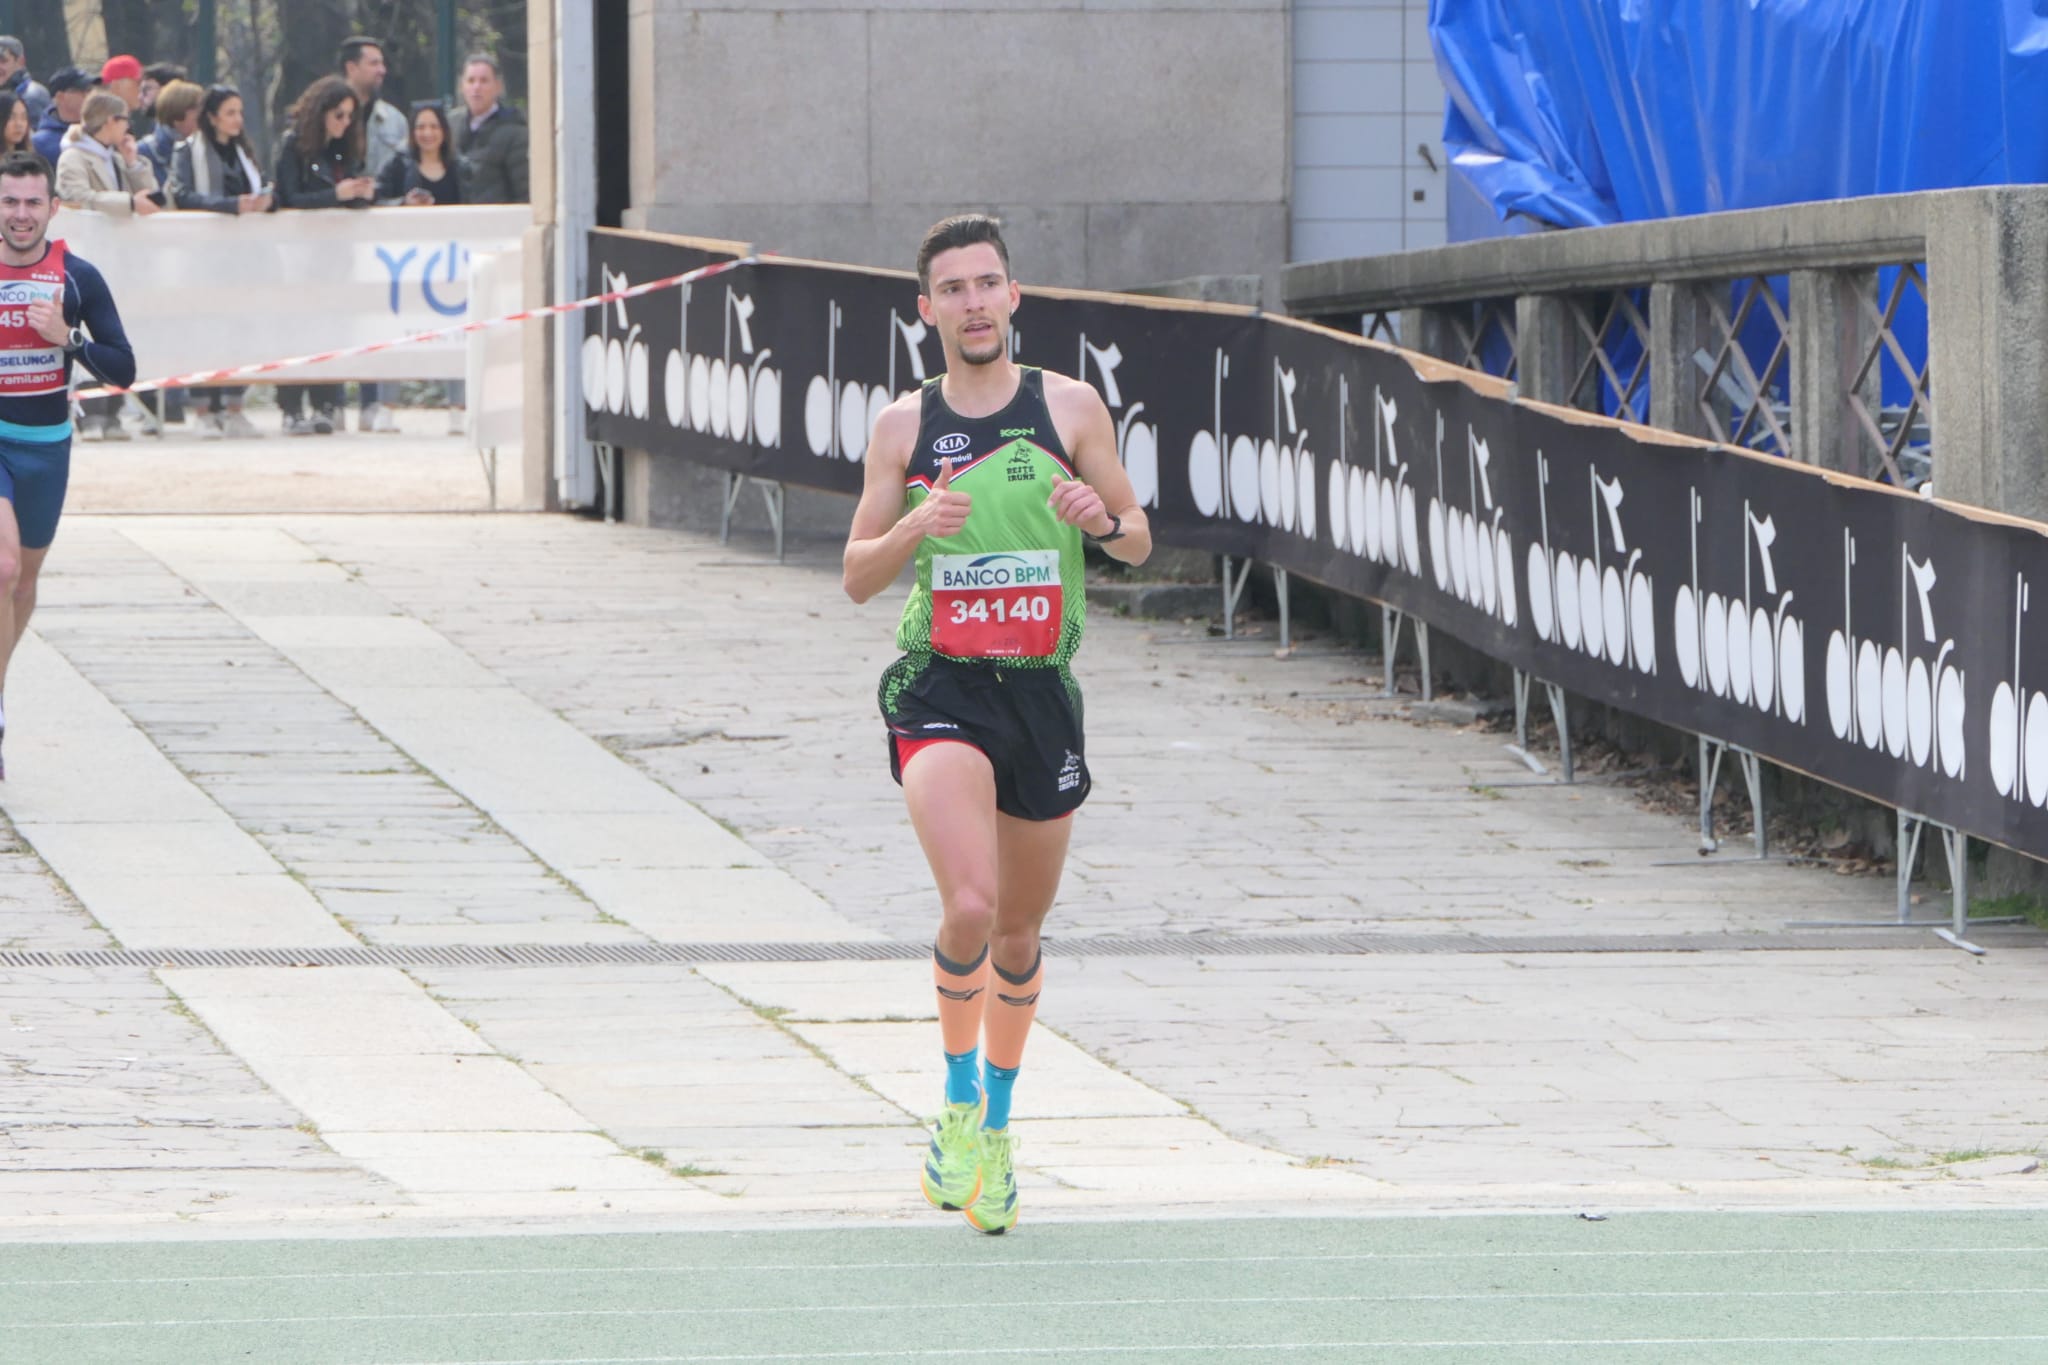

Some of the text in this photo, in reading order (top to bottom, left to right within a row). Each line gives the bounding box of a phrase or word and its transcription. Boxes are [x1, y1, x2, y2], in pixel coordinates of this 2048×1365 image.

[375, 240, 469, 317] YO
[665, 279, 781, 449] diadora
[933, 452, 973, 468] Samóvil
[939, 437, 964, 451] KIA
[1188, 347, 1316, 541] diadora
[1328, 373, 1422, 579] diadora
[1428, 408, 1517, 629] diadora
[943, 566, 1051, 587] BANCO BPM
[950, 596, 1050, 624] 34140
[1527, 449, 1657, 676] diadora
[1674, 486, 1806, 727] diadora
[1826, 526, 1965, 782] diadora
